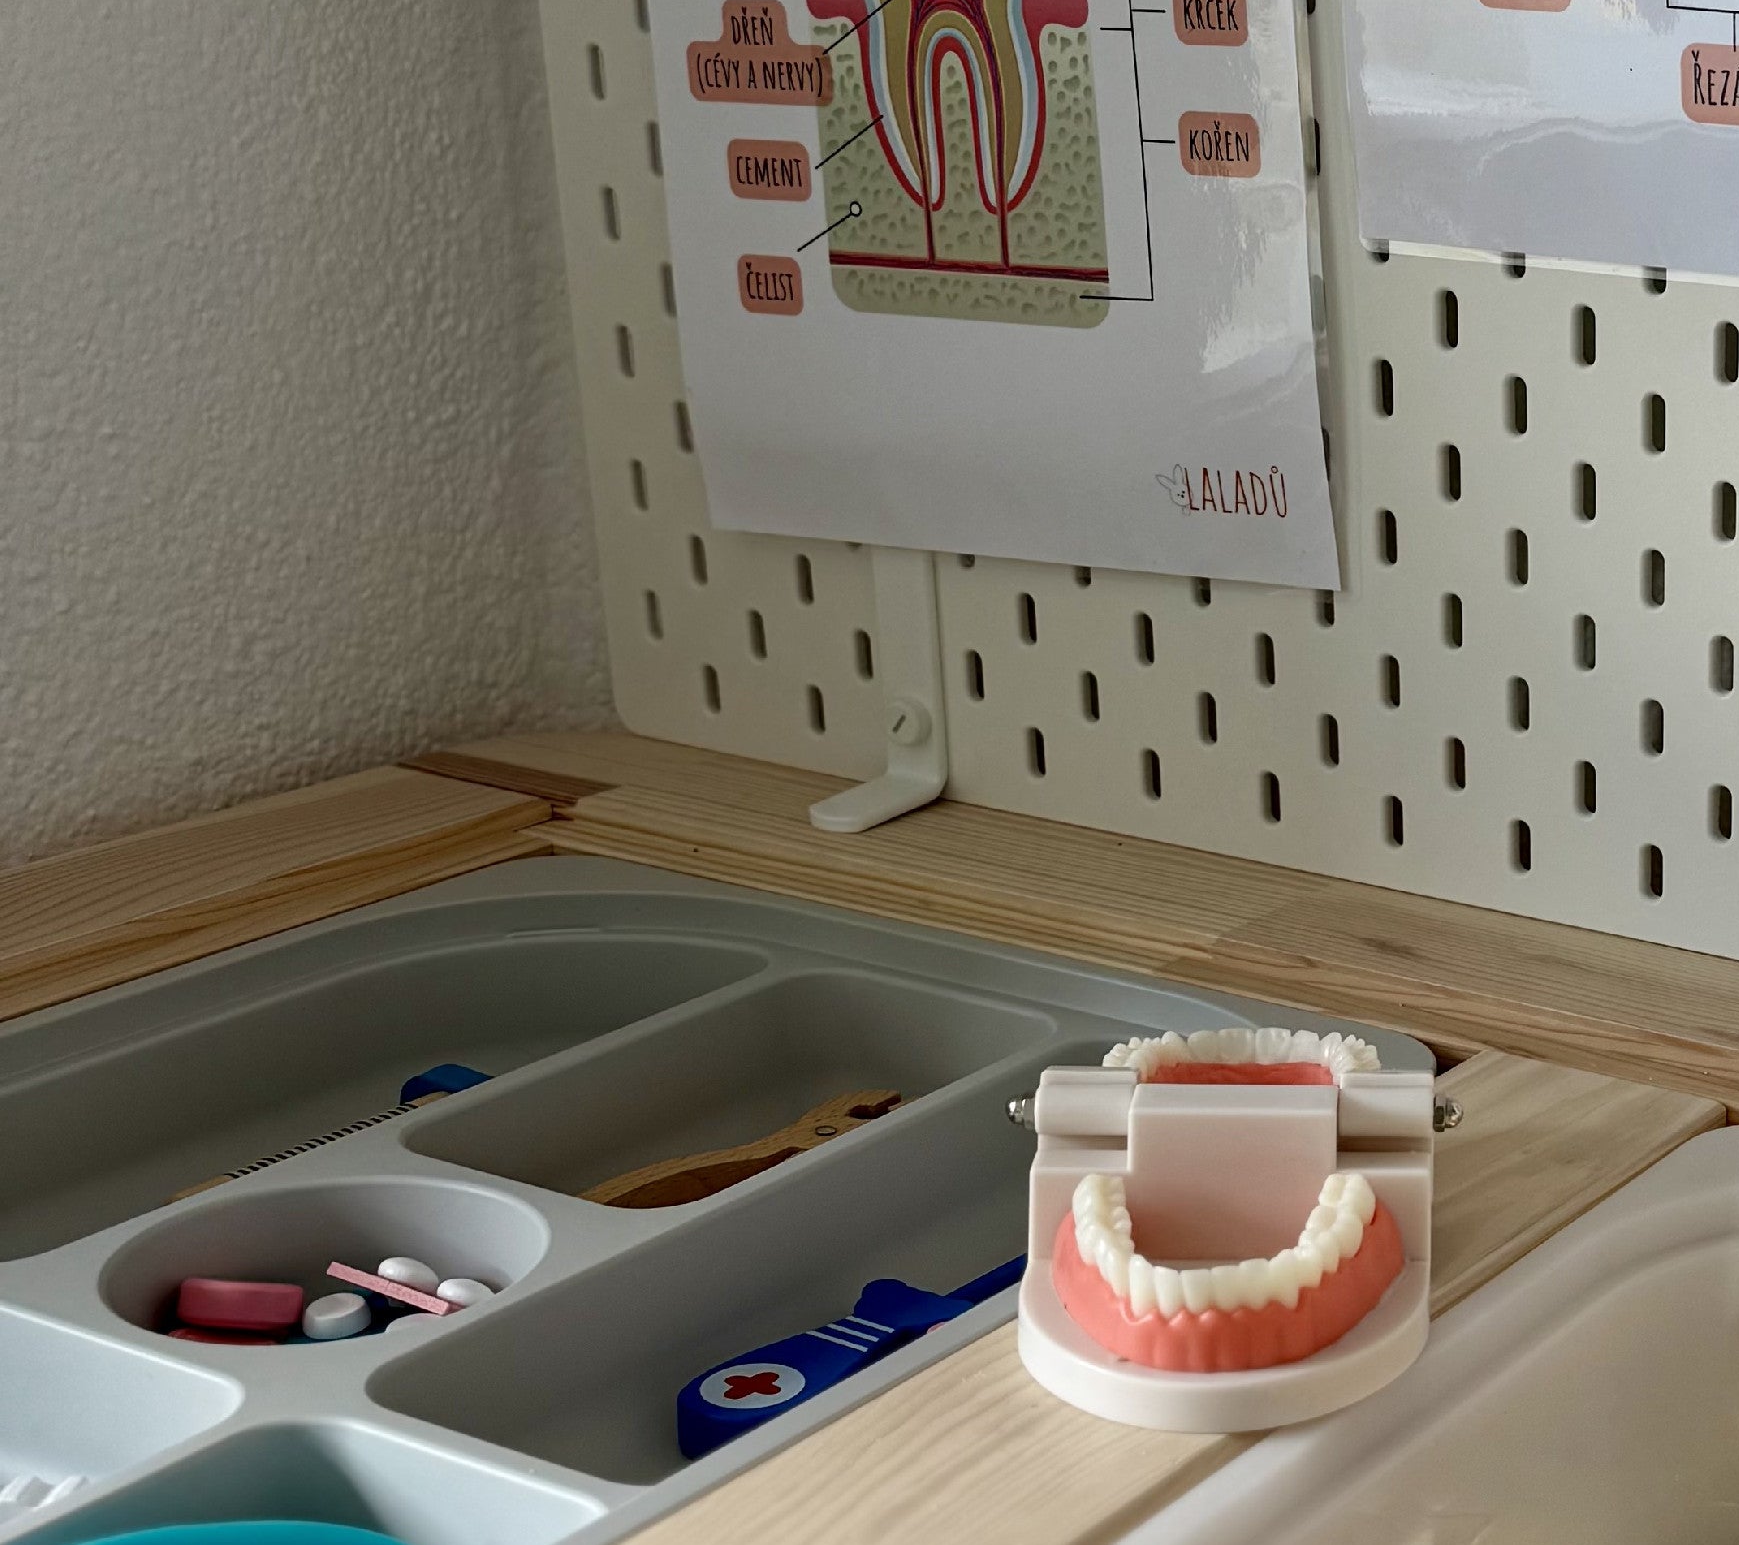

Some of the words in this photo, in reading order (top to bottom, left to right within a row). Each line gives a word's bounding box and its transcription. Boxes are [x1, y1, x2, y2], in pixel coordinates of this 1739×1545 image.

[730, 6, 773, 46] DŘEŇ
[696, 53, 742, 92] (CÉVY
[747, 58, 759, 88] A
[762, 57, 825, 99] NERVY)
[1187, 119, 1252, 163] KOŘEN
[734, 156, 803, 188] CEMENT
[745, 261, 795, 302] ČELIST
[1183, 464, 1290, 518] LALADŮ
